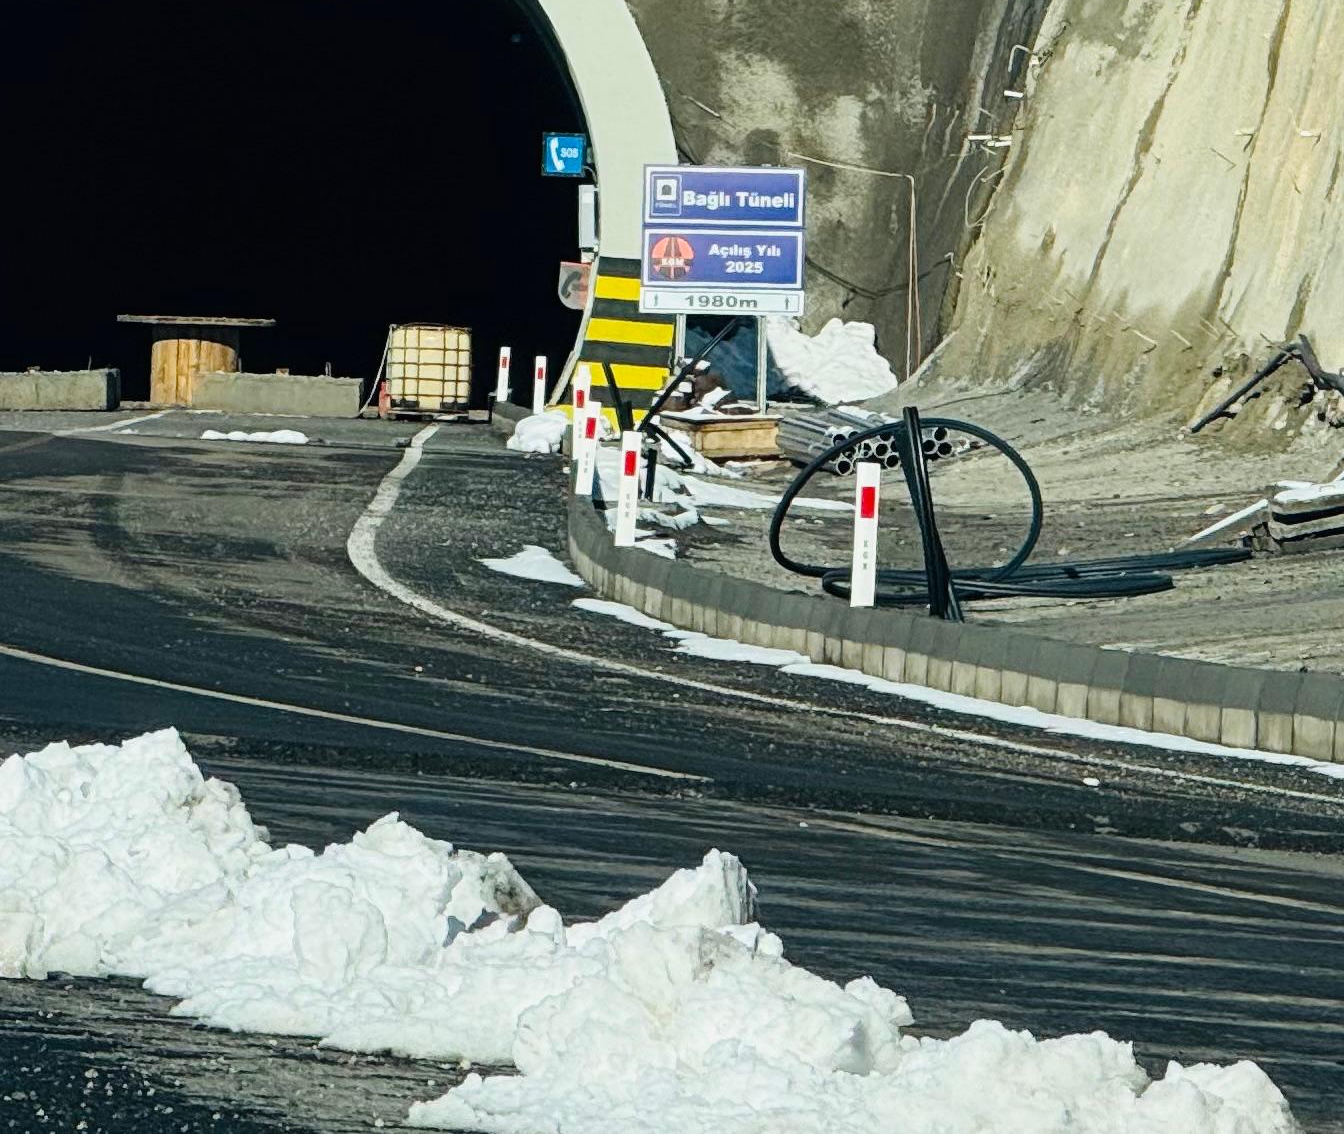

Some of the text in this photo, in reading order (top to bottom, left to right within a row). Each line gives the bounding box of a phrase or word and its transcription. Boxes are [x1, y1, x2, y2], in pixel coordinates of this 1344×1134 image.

[560, 147, 579, 158] SOS
[683, 190, 795, 210] Bağlı Tüneli
[708, 244, 781, 258] Açılış Yılı
[725, 261, 764, 274] 2025
[684, 295, 758, 308] 1980m
